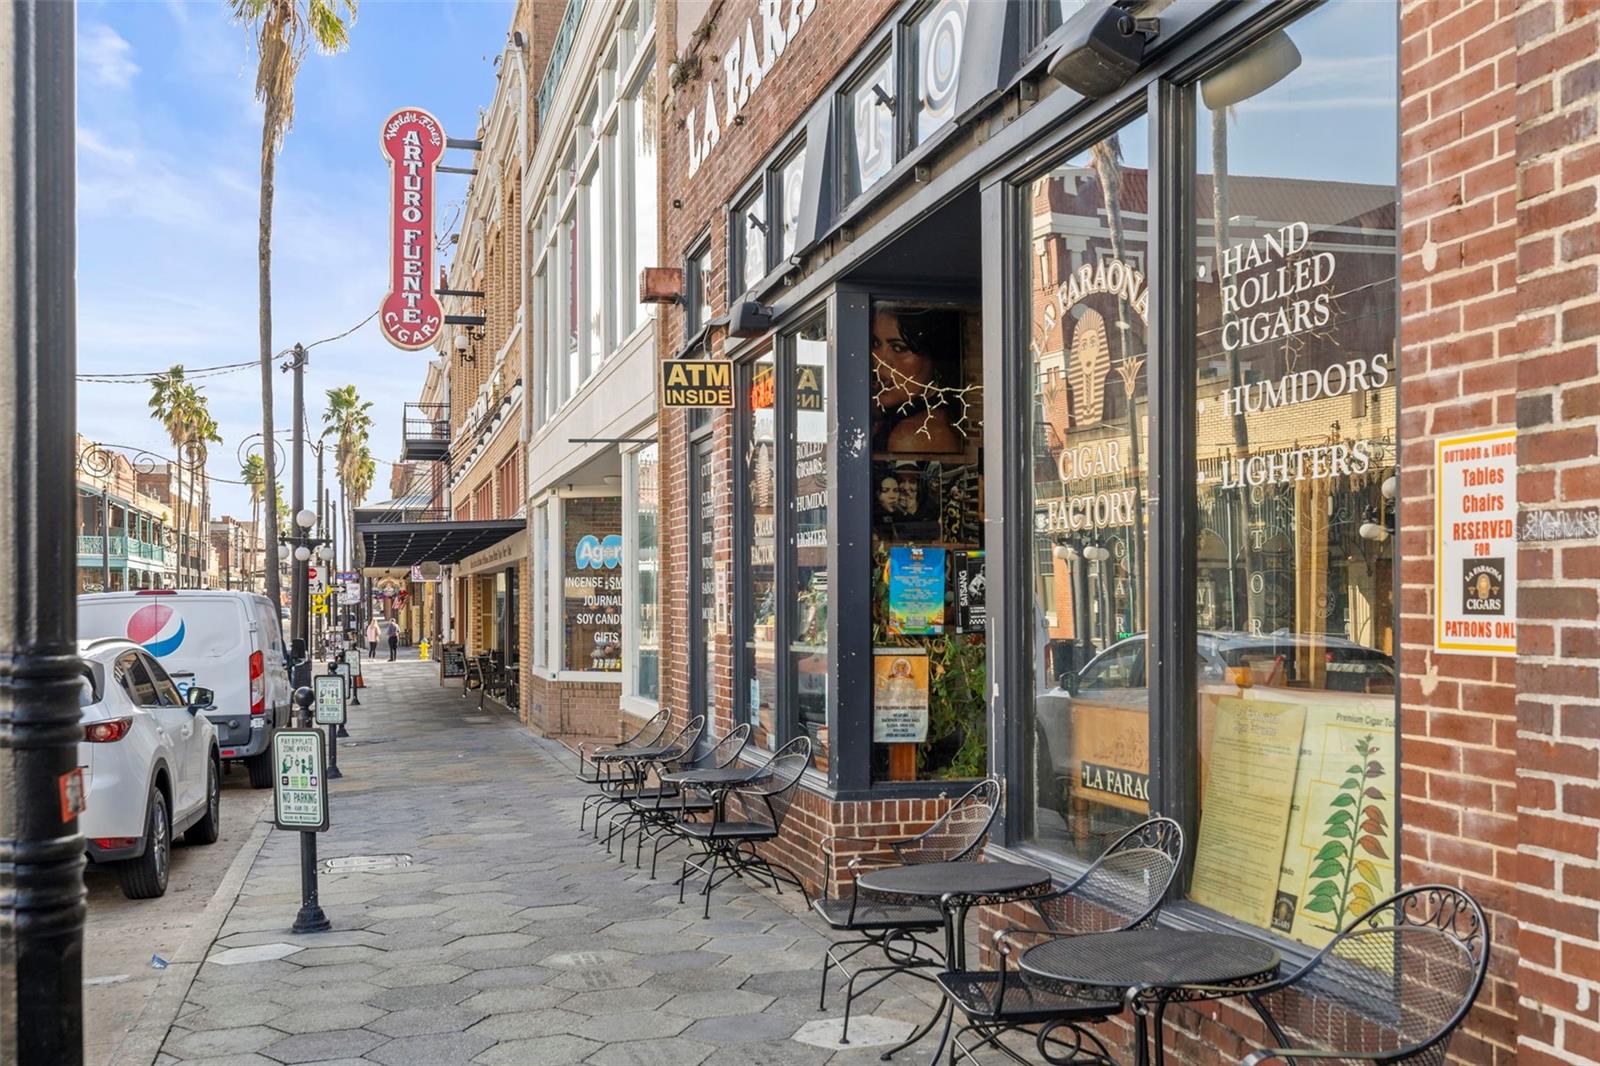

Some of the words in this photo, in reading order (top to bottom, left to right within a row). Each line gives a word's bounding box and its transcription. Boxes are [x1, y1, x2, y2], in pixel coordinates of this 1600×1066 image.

[686, 80, 720, 180] LA
[402, 130, 424, 223] ARTURO
[1222, 221, 1309, 280] HAND
[402, 229, 424, 324] FUENTE
[1222, 251, 1336, 316] ROLLED
[1056, 258, 1149, 327] FARAONA
[384, 310, 440, 344] CIGARS
[1221, 293, 1330, 351] CIGARS
[667, 364, 729, 387] ATM
[1221, 353, 1389, 417] HUMIDORS
[666, 389, 731, 404] INSIDE
[1059, 440, 1121, 482] CIGAR
[1221, 439, 1370, 490] LIGHTERS
[1443, 446, 1482, 463] OUTDOOR
[1483, 447, 1490, 458] &
[1462, 467, 1505, 487] Tables
[1047, 487, 1138, 534] FACTORY
[1462, 494, 1505, 513] Chairs
[1453, 519, 1513, 541] RESERVED
[1474, 543, 1491, 556] FOR
[565, 577, 603, 588] INCENSE
[958, 570, 968, 607] SATSANG
[1466, 598, 1502, 610] CIGARS
[576, 614, 594, 625] SOY
[1445, 620, 1492, 638] PATRONS
[1495, 622, 1517, 639] ONL
[594, 632, 619, 644] GIFTS
[1335, 712, 1364, 724] Premium
[1365, 715, 1383, 727] Cigar
[1085, 765, 1104, 790] LA
[282, 792, 291, 804] NO
[293, 792, 318, 805] PARKING
